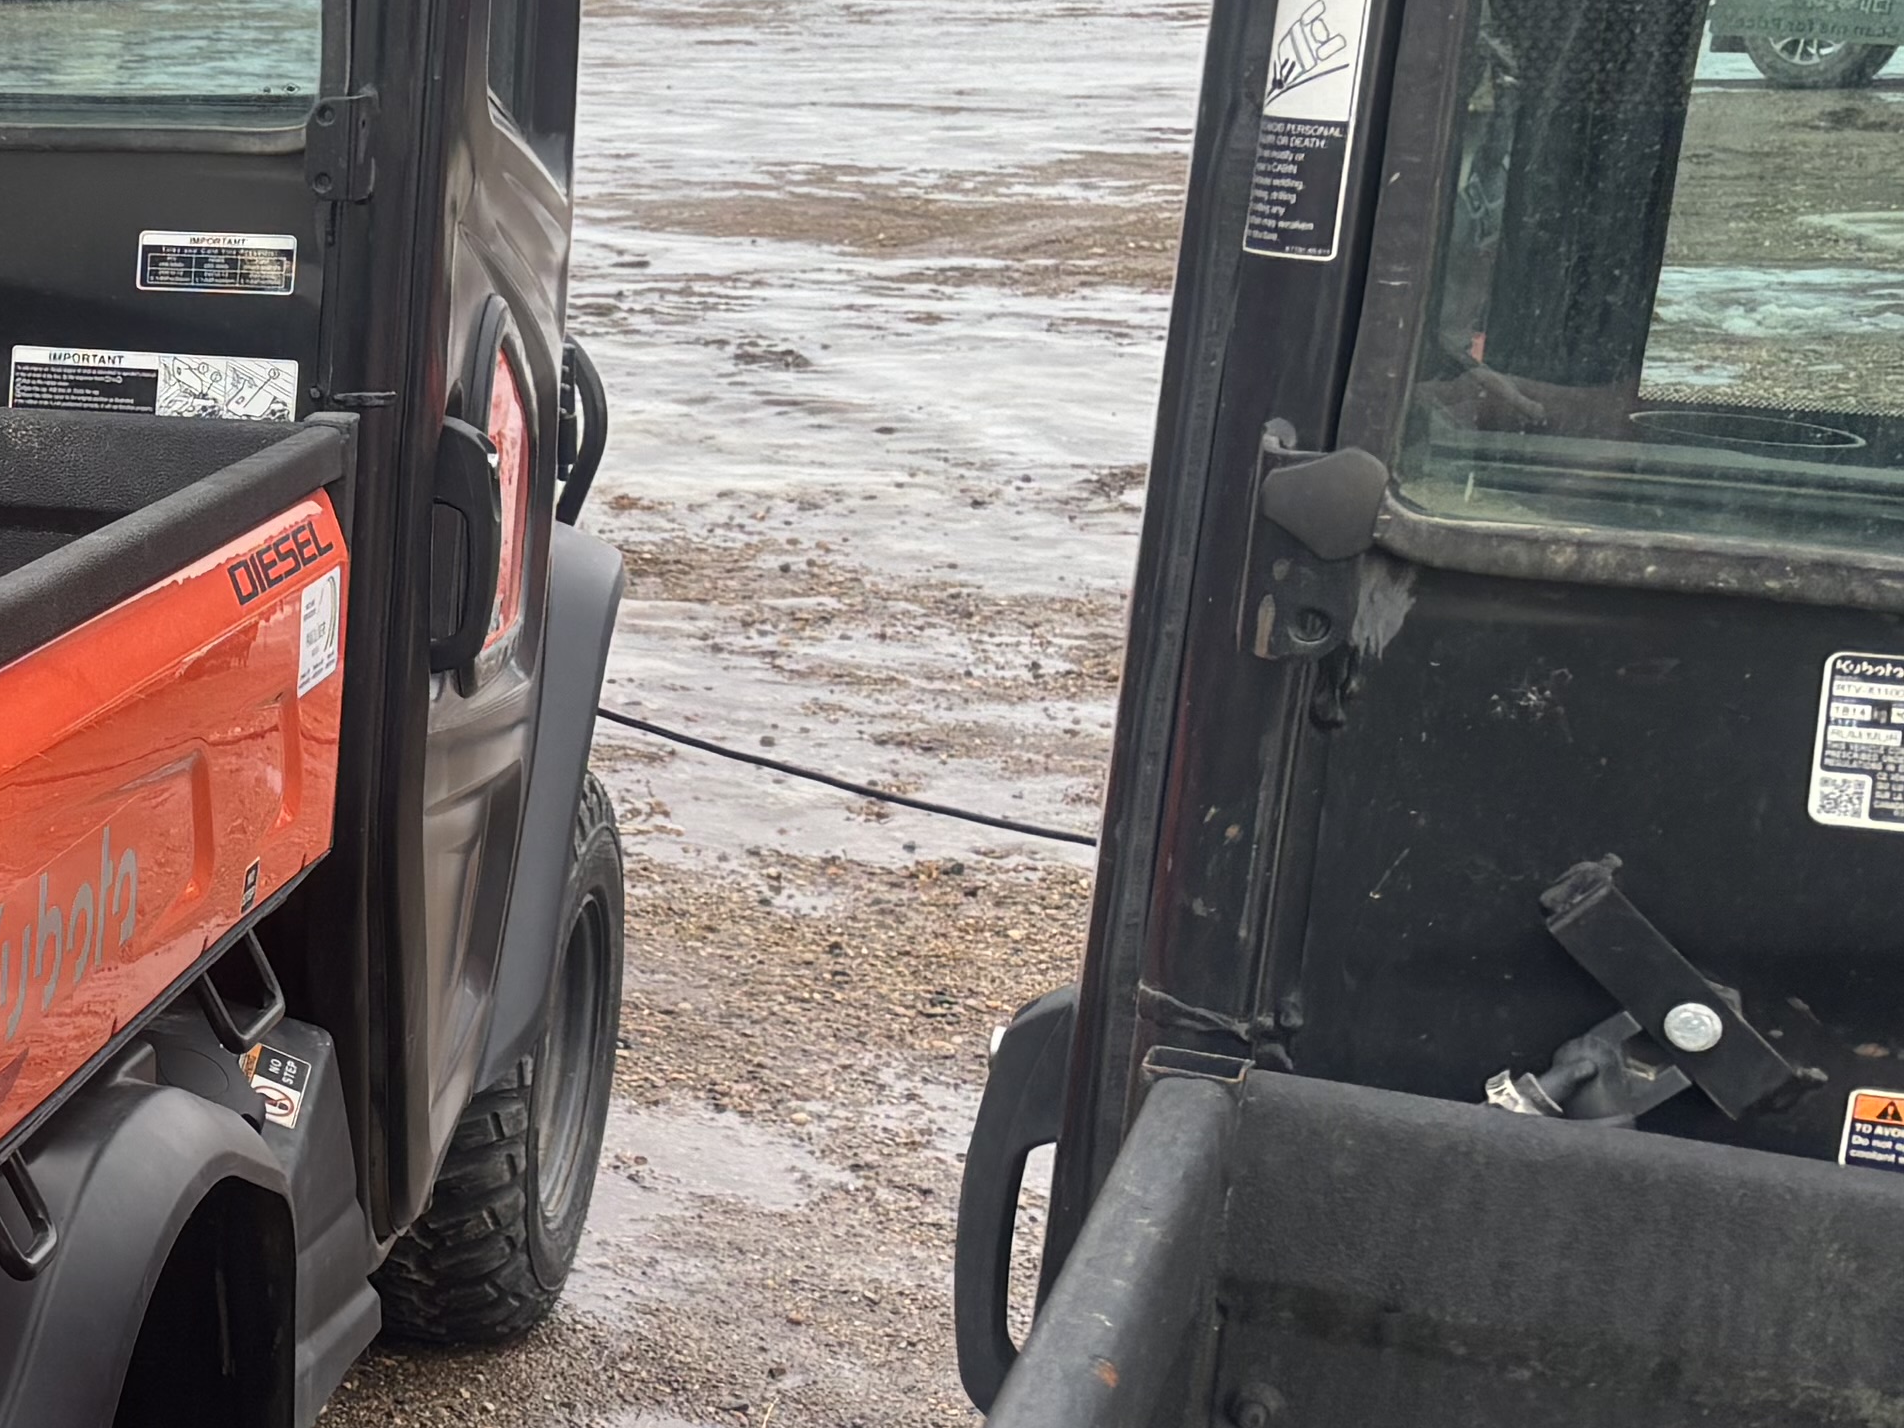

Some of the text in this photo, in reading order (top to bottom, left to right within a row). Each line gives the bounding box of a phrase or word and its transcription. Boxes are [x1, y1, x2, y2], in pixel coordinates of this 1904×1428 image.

[49, 353, 124, 365] IMPORTANT
[227, 520, 334, 606] DIESEL
[1835, 659, 1904, 678] Kubota
[268, 1058, 282, 1075] NO
[281, 1060, 298, 1086] STEP
[1855, 1122, 1873, 1134] TO
[1851, 1134, 1870, 1146] Do
